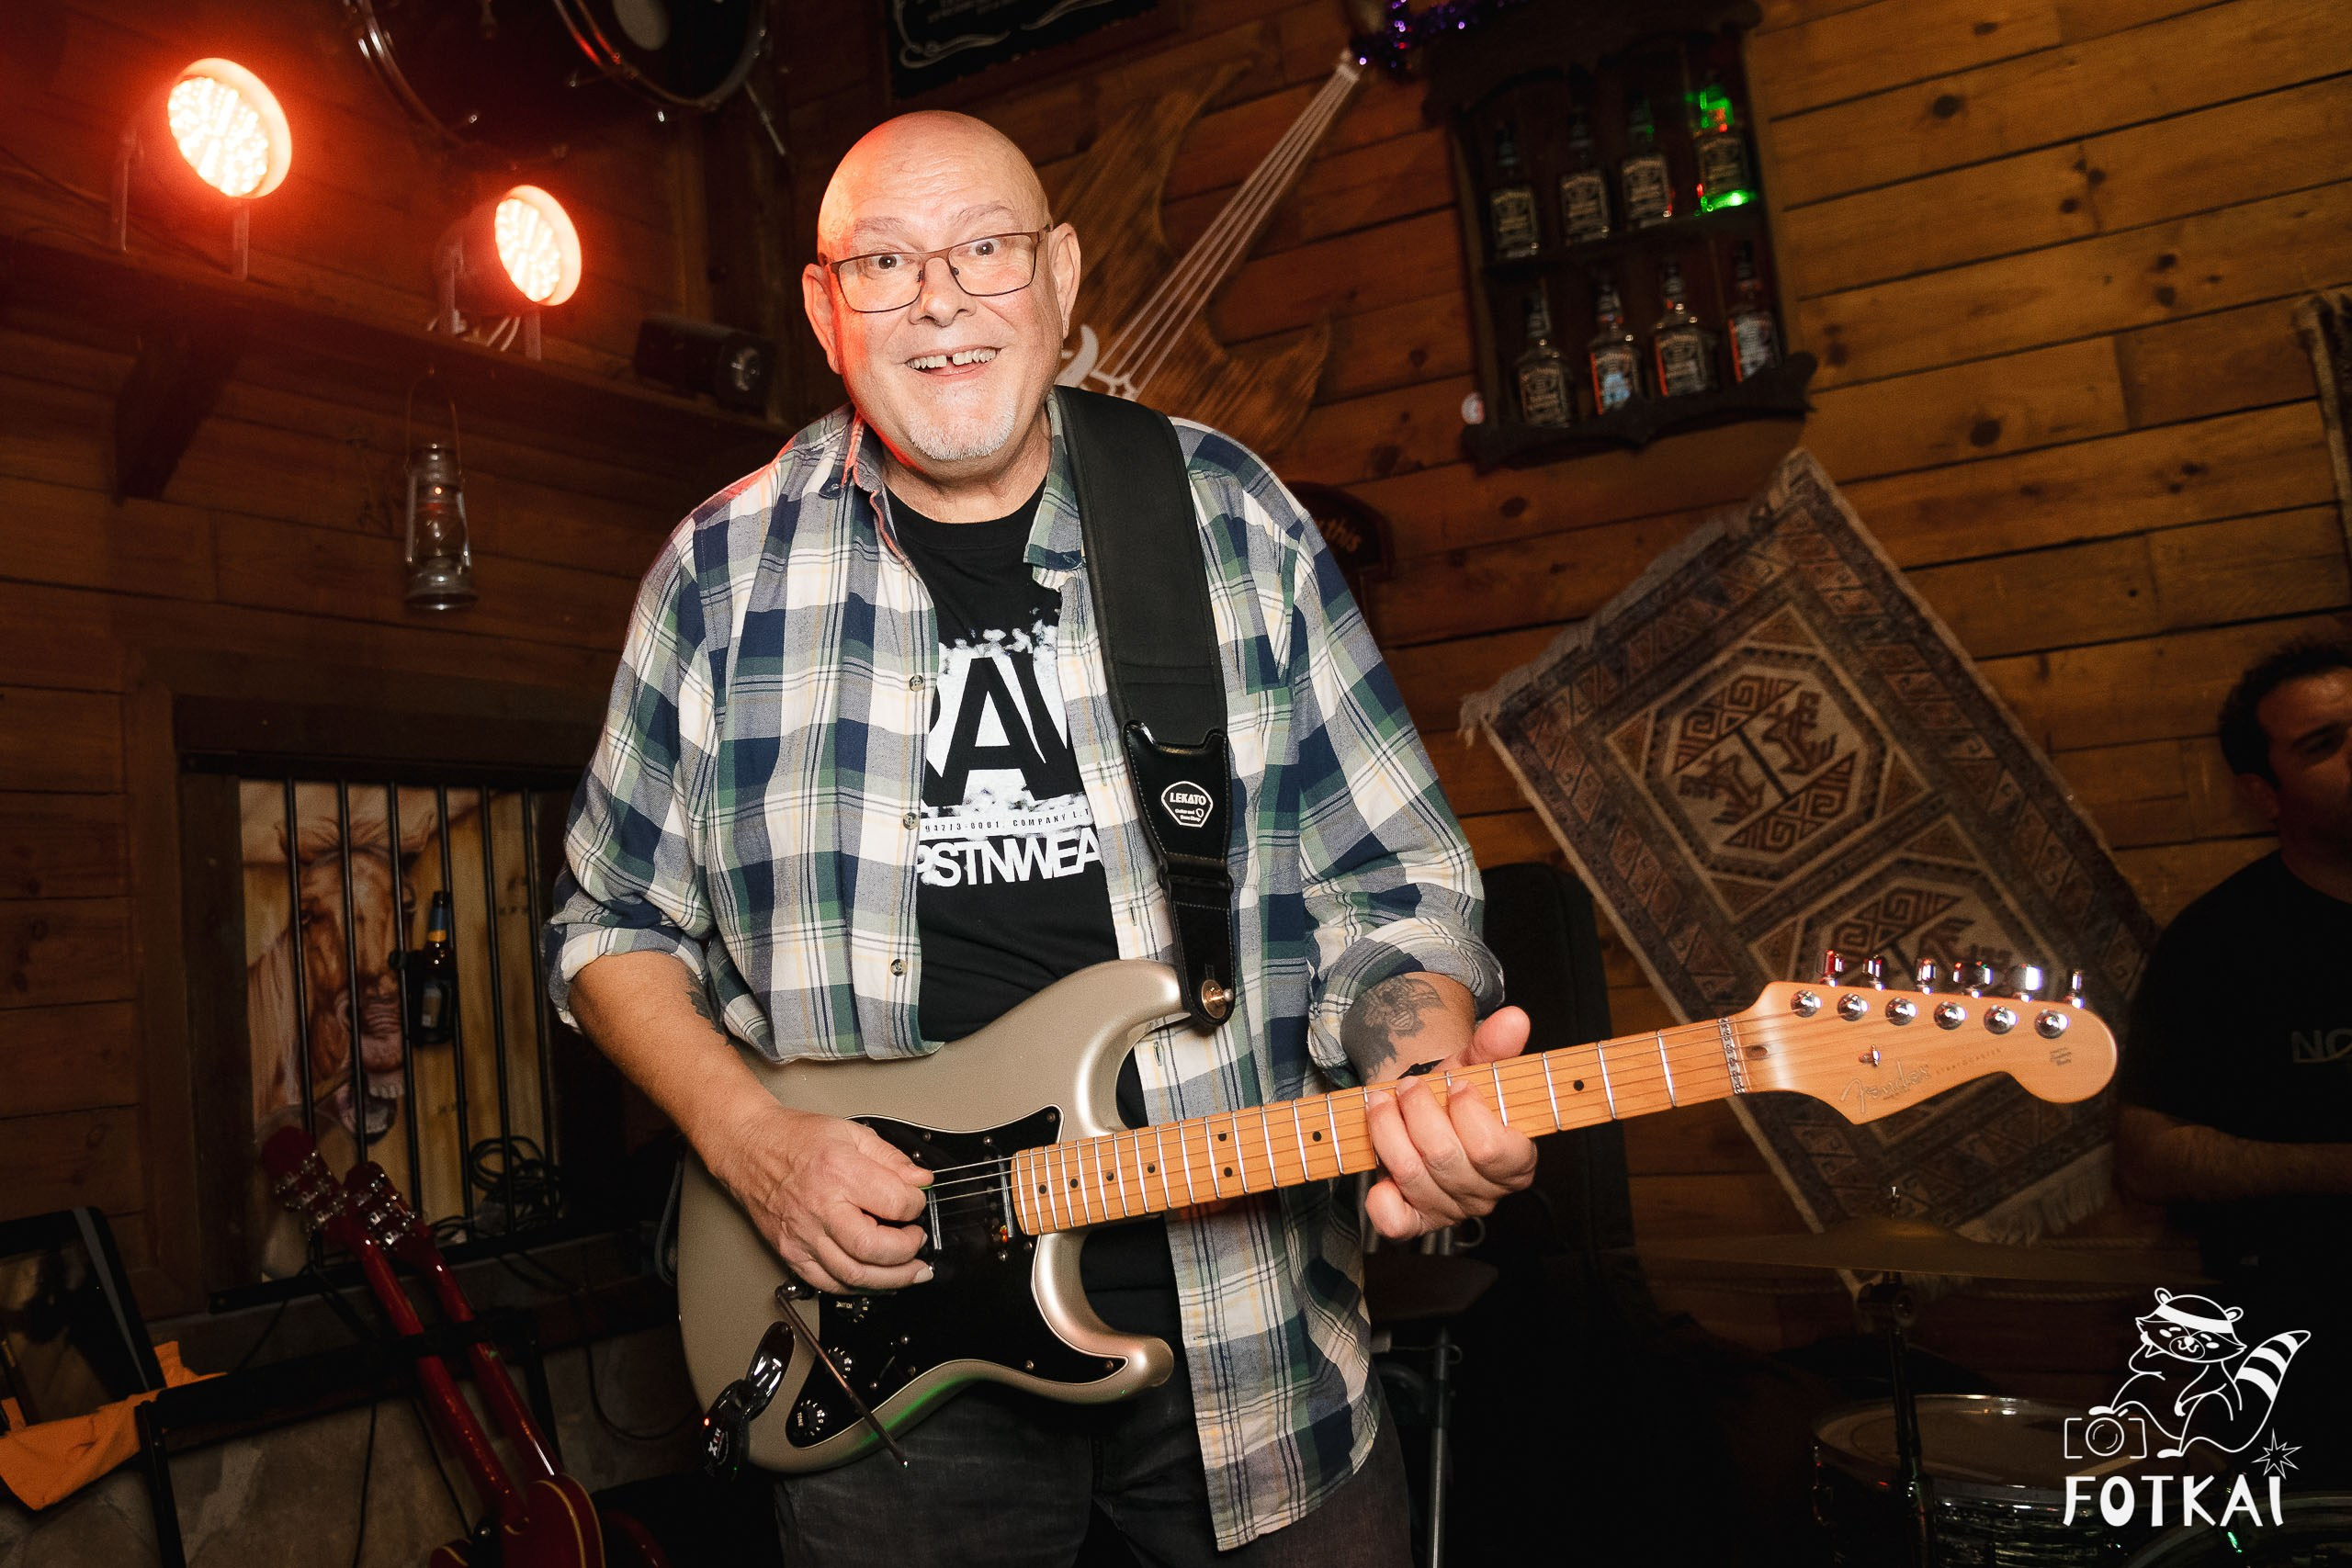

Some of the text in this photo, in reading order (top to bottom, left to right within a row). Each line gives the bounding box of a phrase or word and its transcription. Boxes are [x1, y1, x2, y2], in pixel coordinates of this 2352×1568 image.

[1170, 792, 1206, 806] LEKATO
[1012, 813, 1066, 827] COMPANY
[1839, 1058, 1931, 1114] Fender
